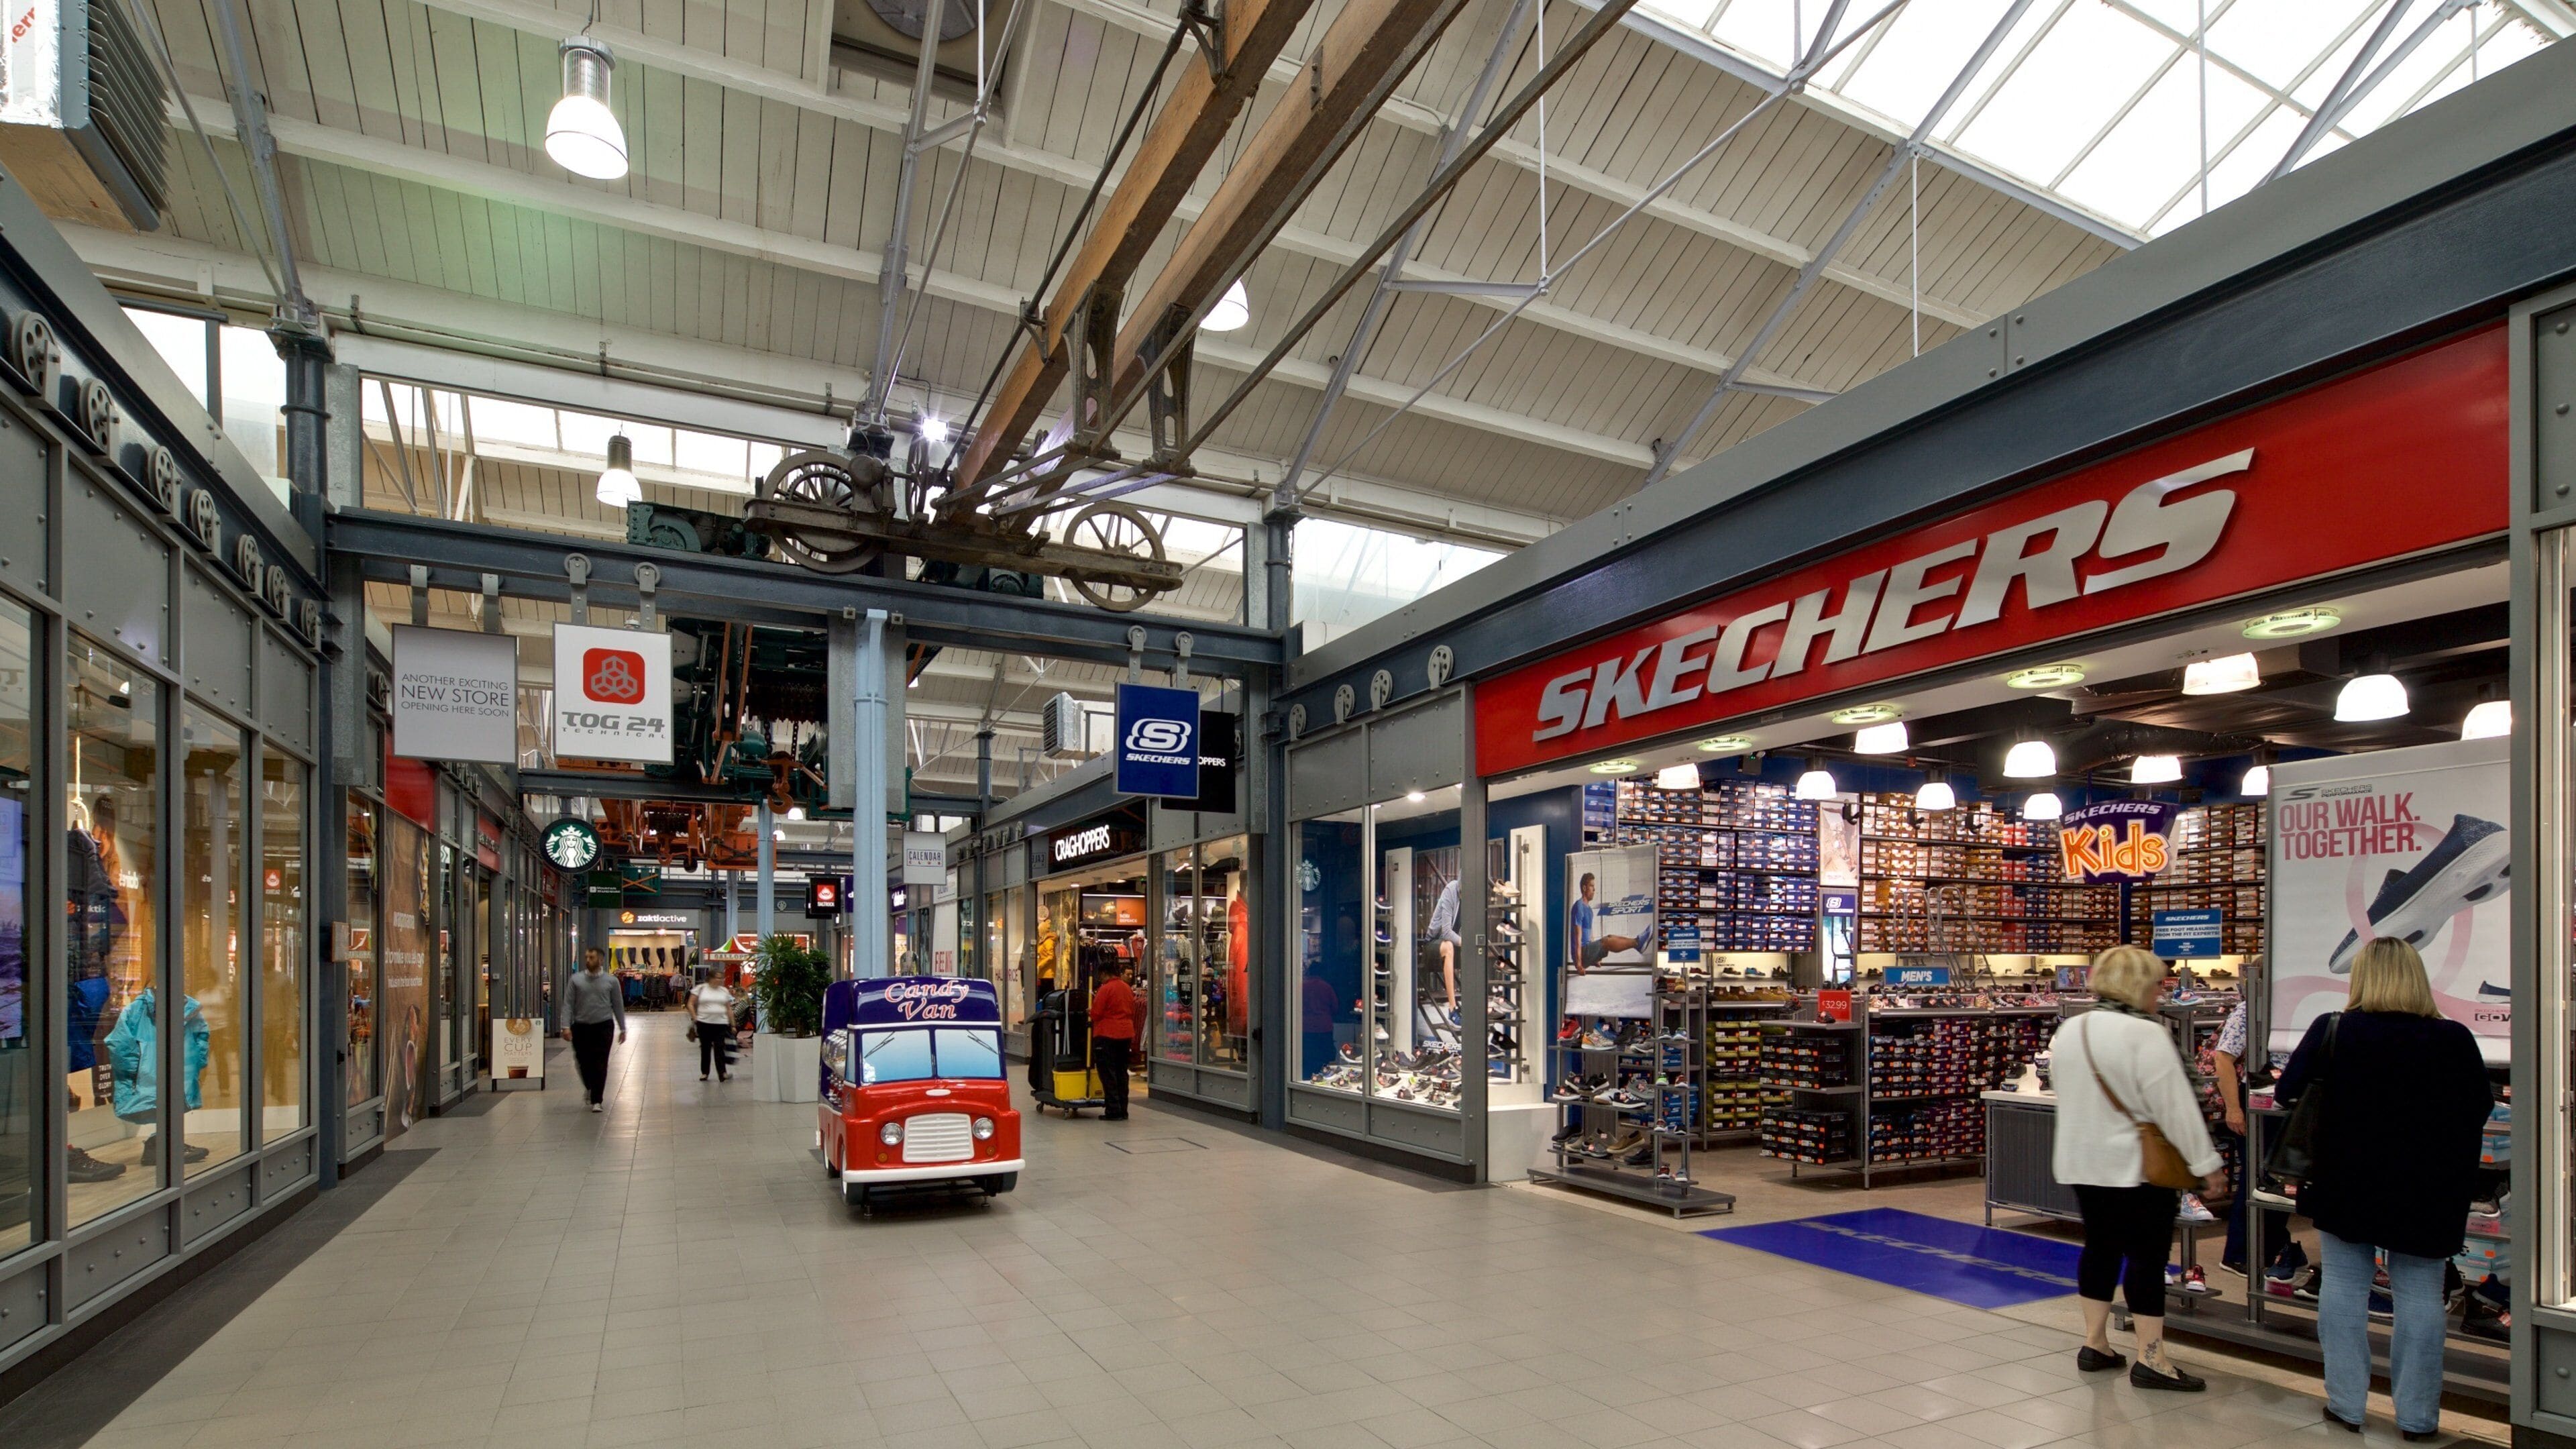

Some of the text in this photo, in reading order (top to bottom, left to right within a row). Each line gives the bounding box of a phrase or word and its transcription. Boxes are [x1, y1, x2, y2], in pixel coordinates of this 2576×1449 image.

[1533, 447, 2255, 743] SKECHERS
[402, 674, 508, 691] ANOTHER EXCITING
[402, 684, 509, 706] NEW STORE
[401, 701, 508, 717] OPENING HERE SOON
[561, 711, 665, 733] TOG 24
[562, 727, 665, 739] TECHNICAL
[1126, 753, 1191, 765] SKECHERS
[2321, 784, 2372, 794] SKECHERS
[2321, 790, 2372, 798] PERFORMANCE
[2064, 803, 2162, 824] SKECHERS
[2279, 792, 2420, 833] OUR WALK.
[1055, 824, 1110, 861] CRAGHOPPERS
[2060, 820, 2169, 879] Kids
[2280, 823, 2422, 861] TOGETHER.
[909, 851, 941, 861] CALENDAR
[1608, 899, 1651, 907] SKECHERS
[1611, 906, 1644, 914] SPORT
[1901, 971, 1933, 982] MEN'S
[885, 980, 969, 1003] Candy
[898, 998, 957, 1020] Van
[504, 1042, 532, 1051] CUP
